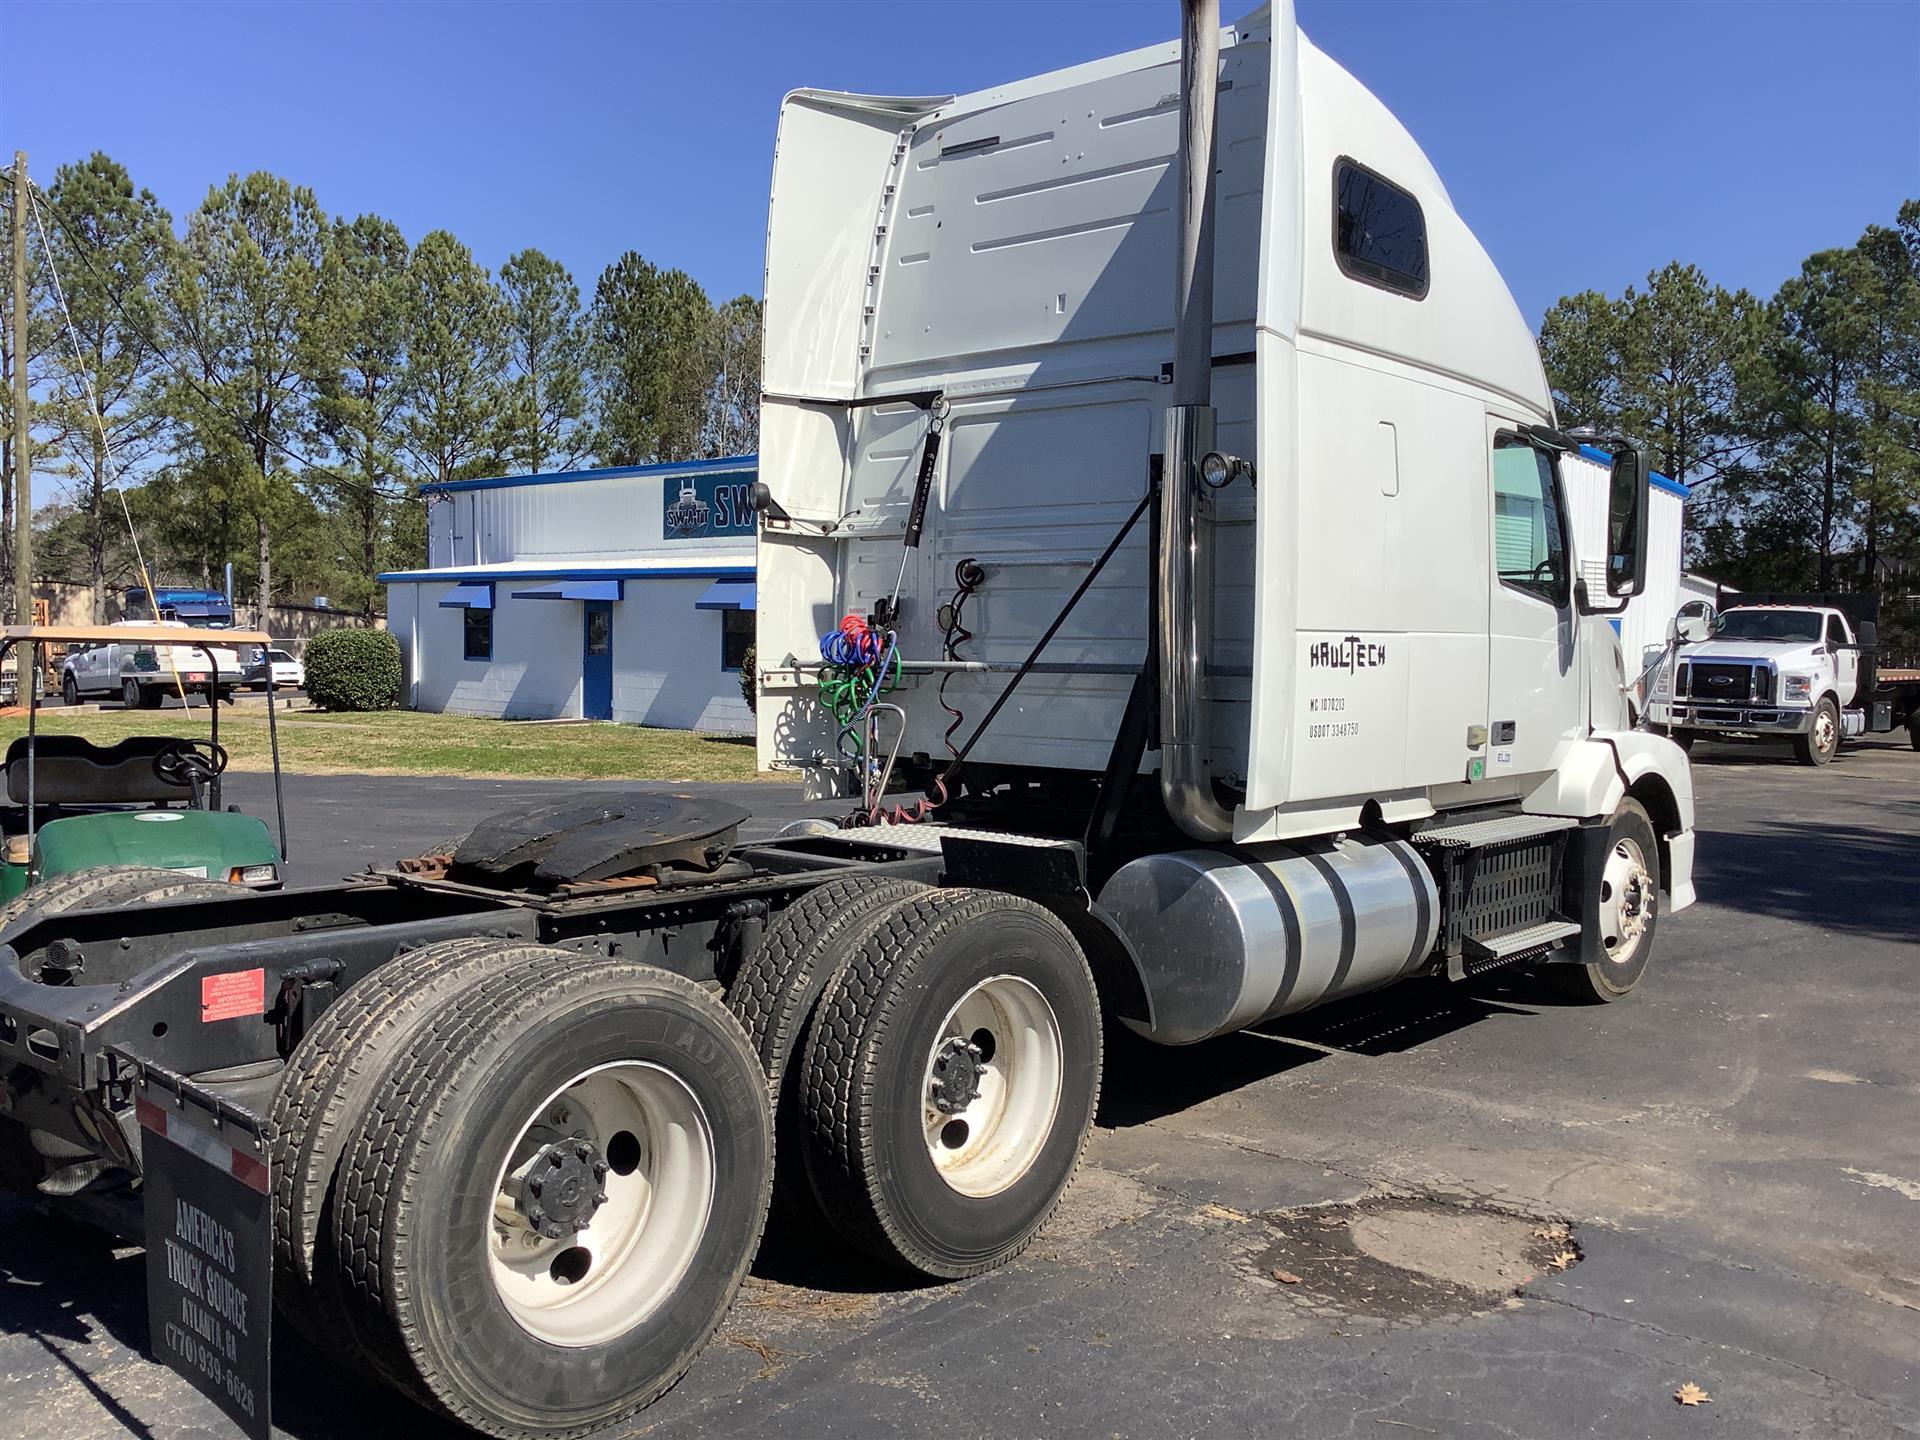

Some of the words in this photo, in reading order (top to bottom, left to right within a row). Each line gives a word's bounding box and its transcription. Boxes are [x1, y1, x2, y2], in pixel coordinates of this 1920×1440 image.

[667, 508, 710, 527] SWATT
[1310, 698, 1319, 712] MC
[1321, 697, 1345, 711] 1070213
[1309, 724, 1330, 738] USDOT
[176, 1198, 235, 1273] AMERICA'S
[165, 1238, 205, 1300] TRUCK
[206, 1265, 249, 1336] SOURCE
